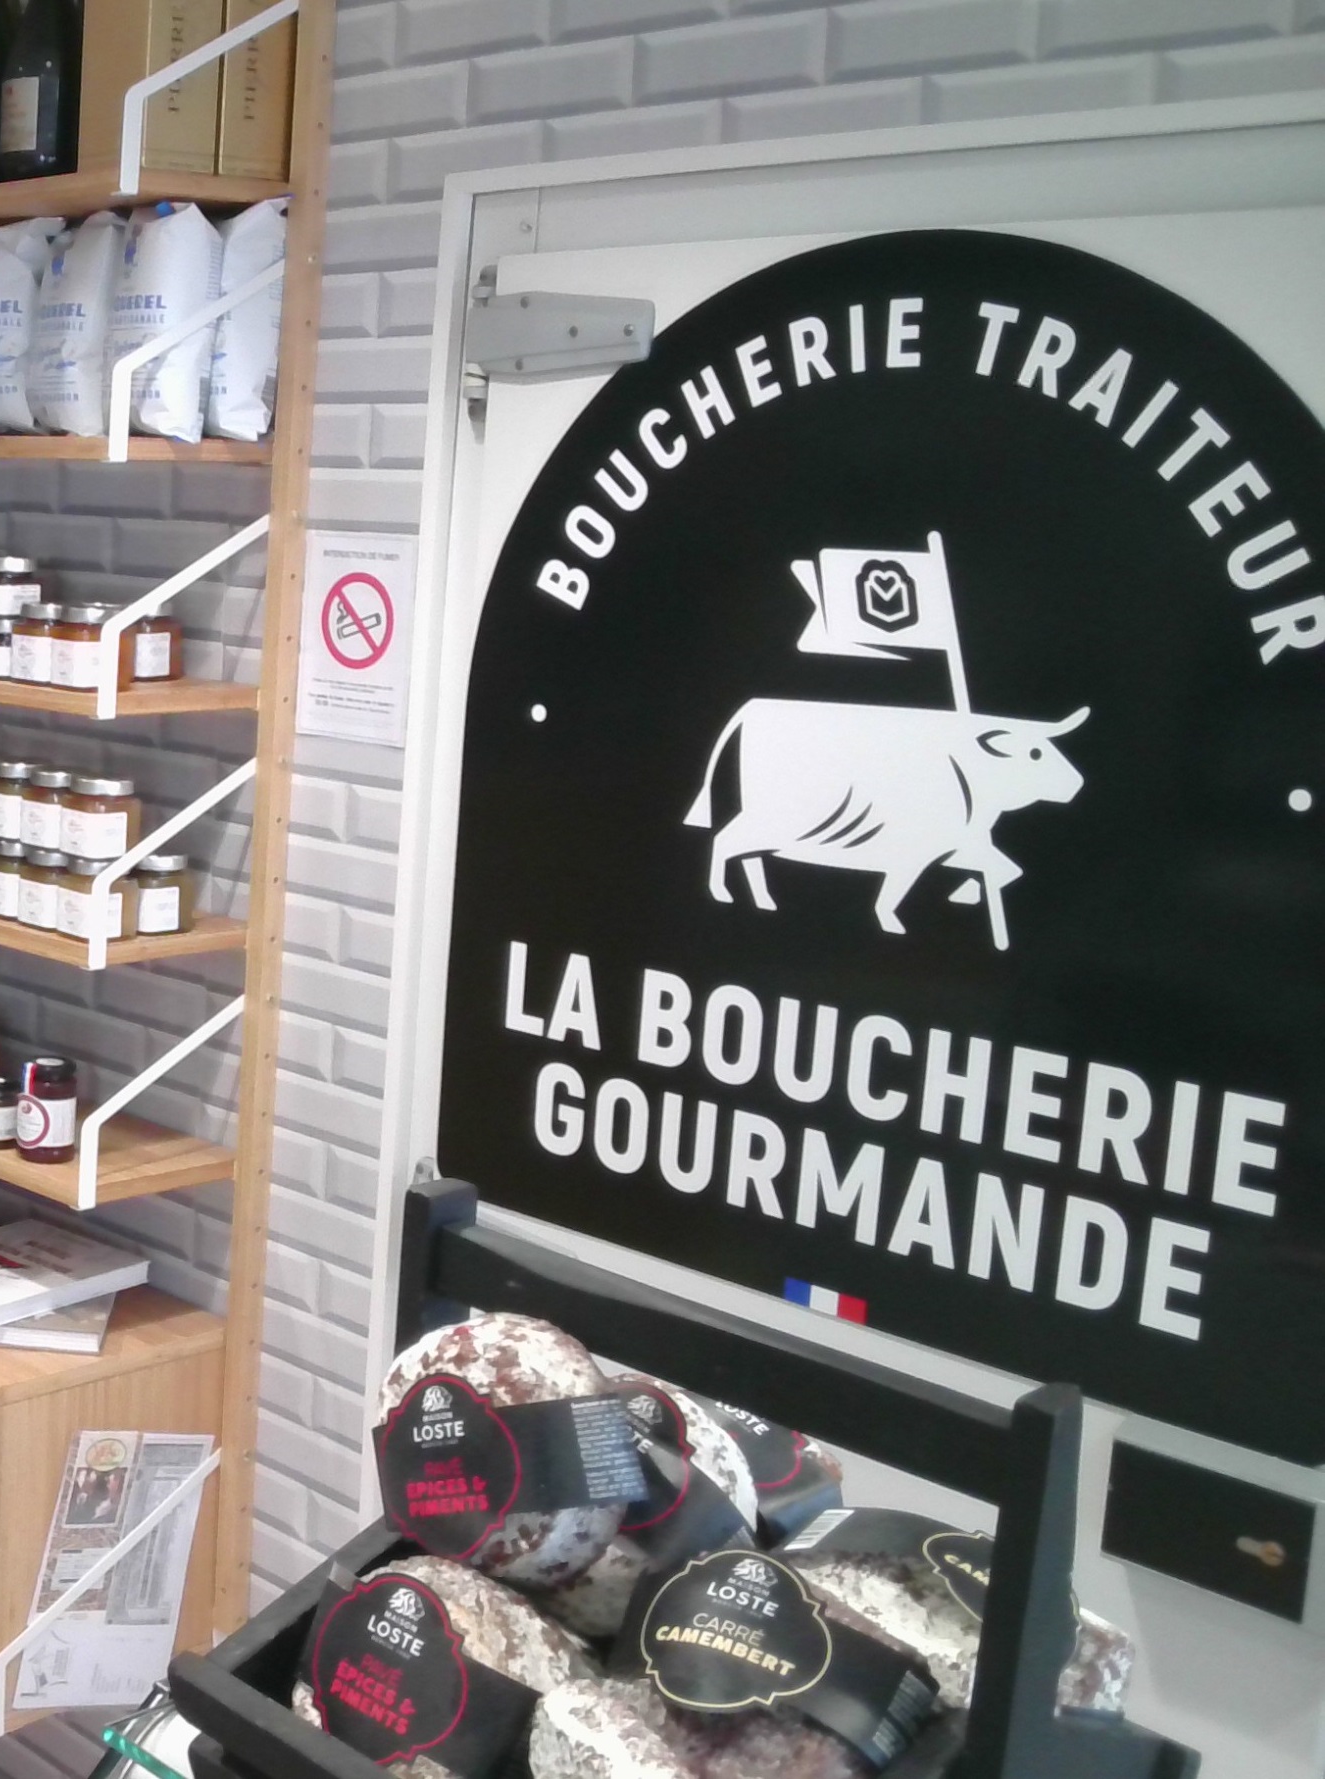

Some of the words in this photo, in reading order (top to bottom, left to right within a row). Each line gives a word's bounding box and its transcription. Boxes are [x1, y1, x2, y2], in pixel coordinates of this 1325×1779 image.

[536, 297, 924, 611] BOUCHERIE
[975, 301, 1325, 666] TRAITEUR
[505, 941, 601, 1051] LA
[637, 968, 1286, 1217] BOUCHERIE
[534, 1063, 1211, 1341] GOURMANDE
[413, 1420, 465, 1442] LOSTE
[408, 1494, 489, 1517] PIMENTS
[706, 1581, 779, 1617] LOSTE
[727, 1577, 770, 1597] MAISON
[367, 1614, 424, 1657] LOSTE
[384, 1610, 418, 1633] MAISON
[692, 1612, 765, 1647] CARRÉ
[655, 1625, 796, 1676] CAMEMBERT
[330, 1679, 408, 1735] PIMENTS
[399, 1698, 416, 1715] &
